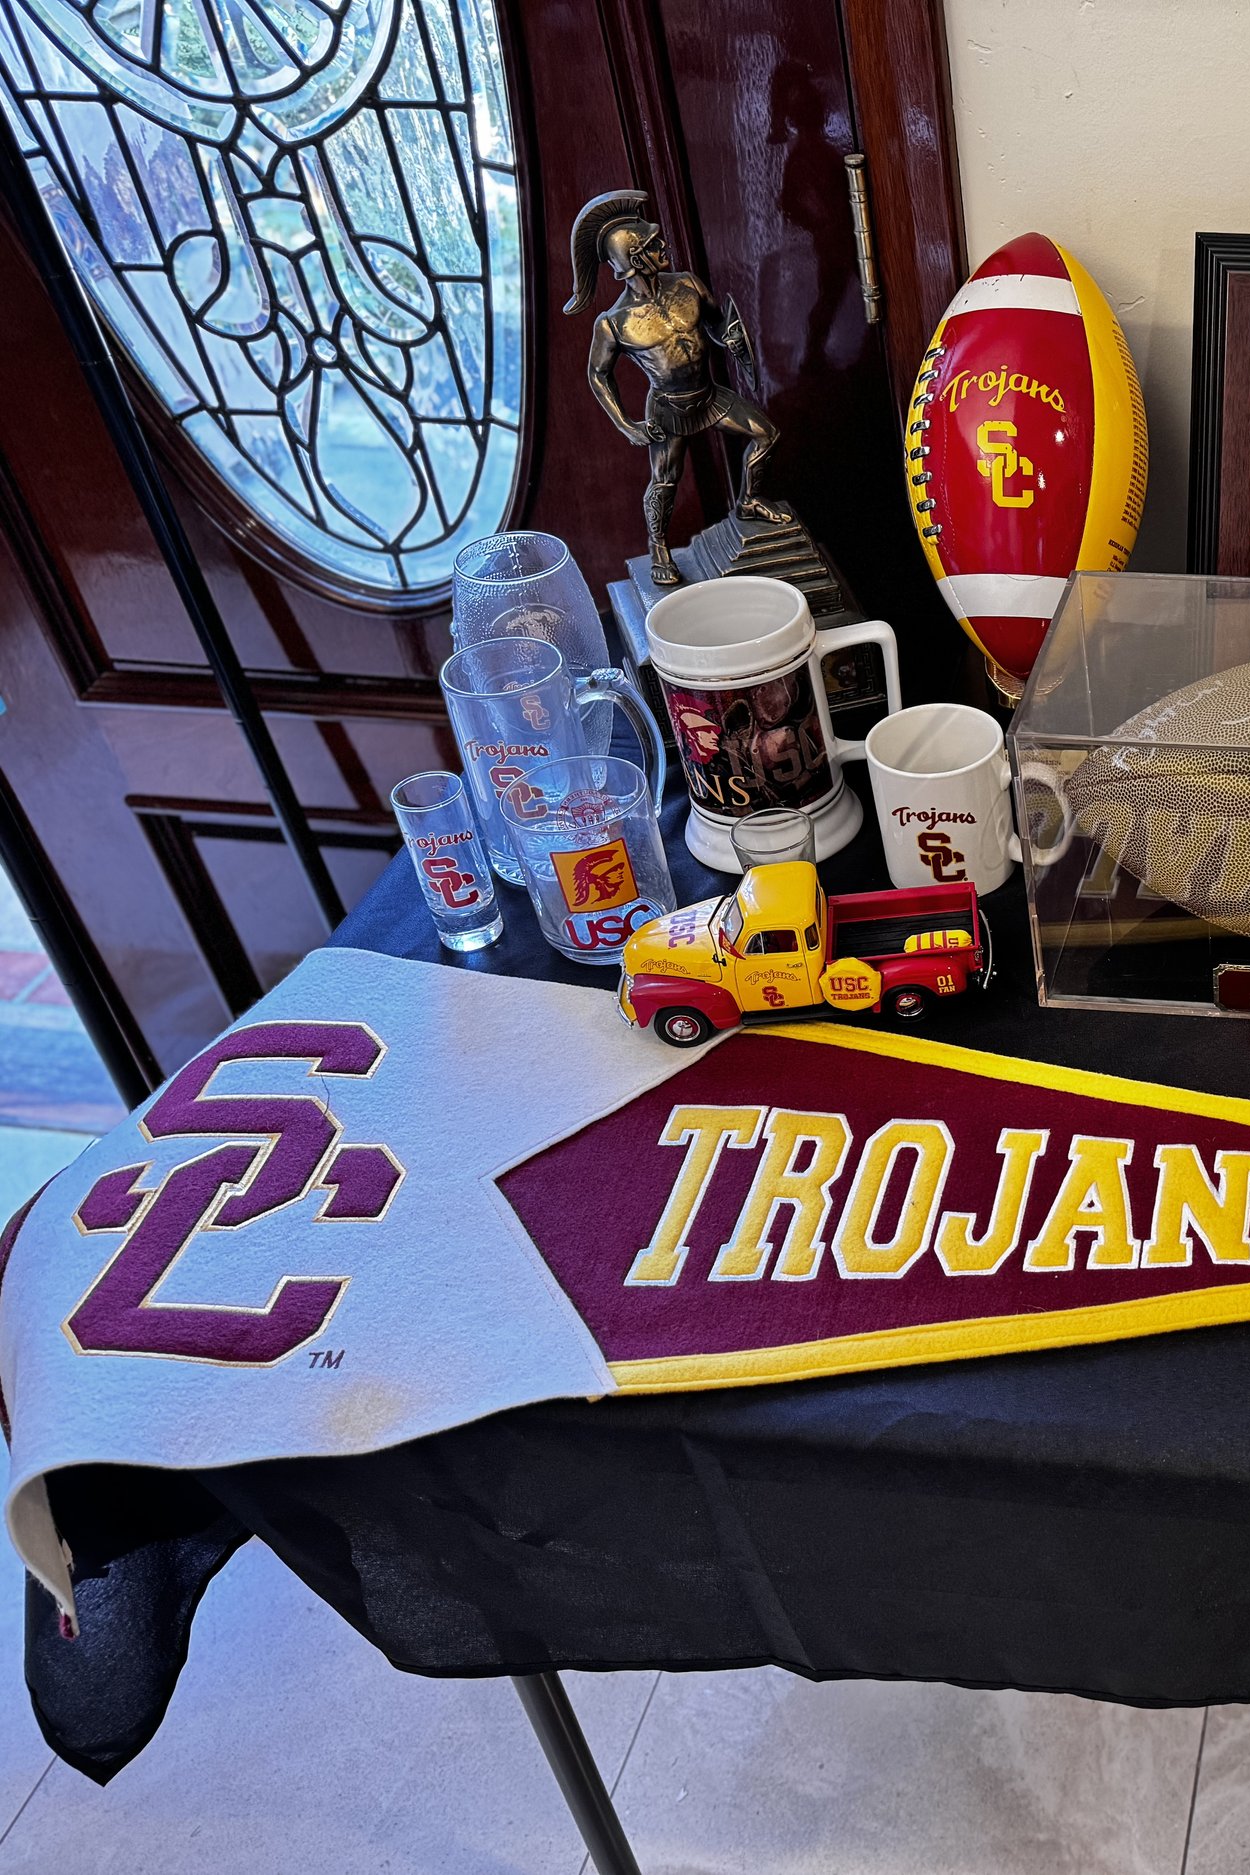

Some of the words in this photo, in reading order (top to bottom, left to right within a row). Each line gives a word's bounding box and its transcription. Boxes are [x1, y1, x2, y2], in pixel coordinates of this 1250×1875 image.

[939, 365, 1067, 413] Trojans
[976, 420, 1034, 508] SC
[464, 737, 550, 765] Trojans
[488, 765, 549, 820] SC
[891, 806, 977, 831] Trojans
[406, 829, 474, 857] rojans
[917, 831, 967, 883] SC
[420, 856, 480, 910] SC
[564, 903, 652, 950] USC
[640, 958, 691, 975] Trojans
[744, 968, 800, 986] Trojans
[829, 976, 870, 992] USC
[936, 974, 954, 987] 01
[938, 985, 956, 994] FAN
[761, 985, 786, 1008] SC
[830, 992, 871, 1001] TROJANS
[60, 1019, 408, 1370] SC
[307, 1349, 346, 1370] TM
